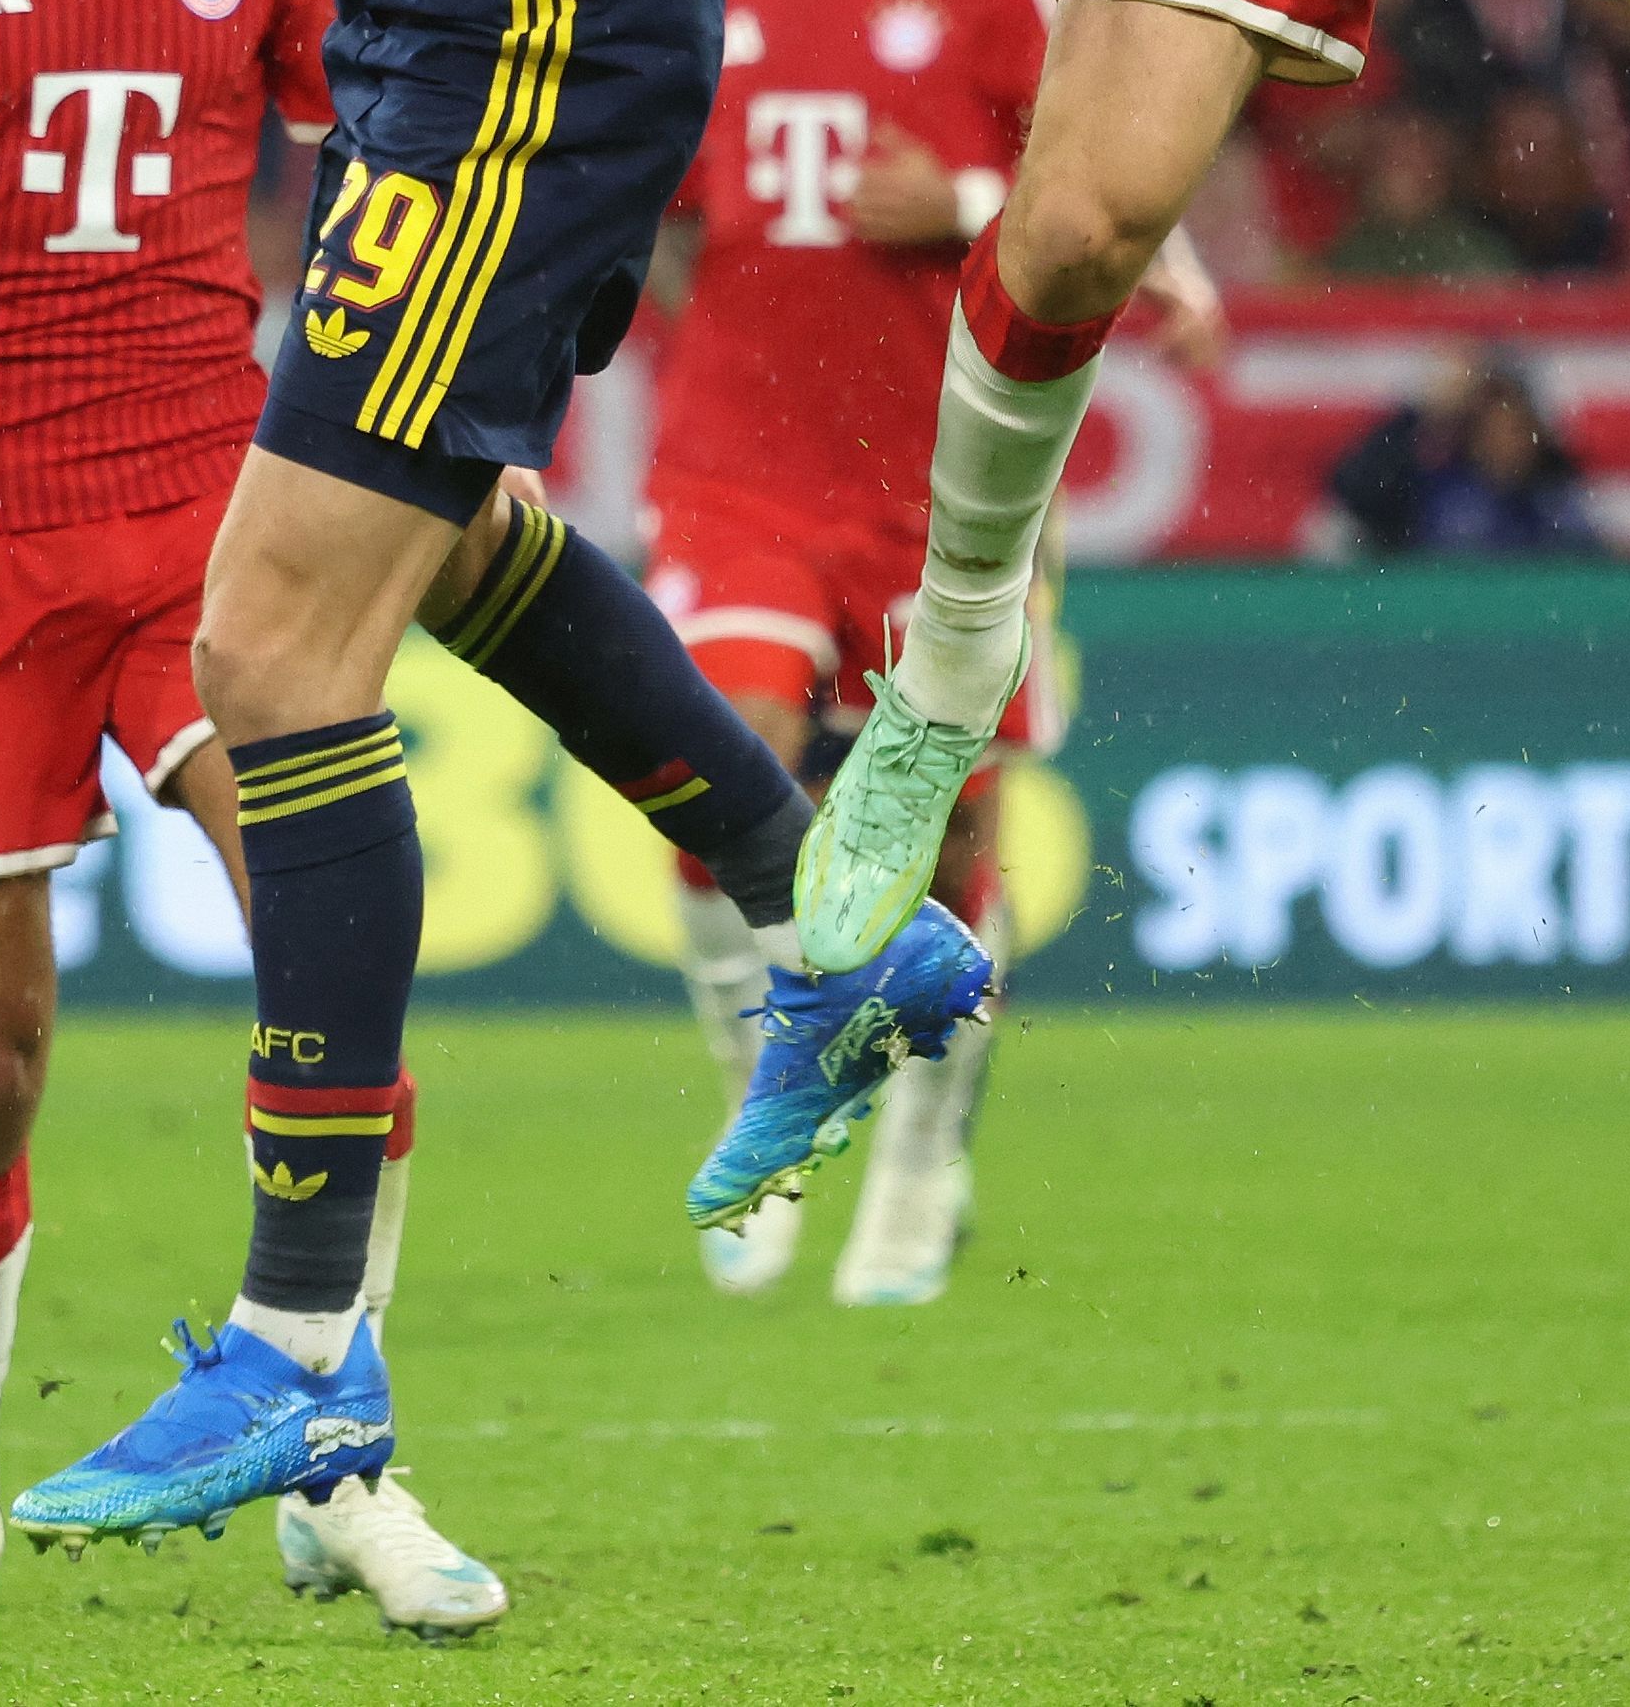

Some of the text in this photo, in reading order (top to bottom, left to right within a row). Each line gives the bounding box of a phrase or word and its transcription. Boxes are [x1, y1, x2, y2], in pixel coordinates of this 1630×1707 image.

[22, 70, 183, 253] T
[302, 156, 444, 313] 29
[745, 91, 869, 248] T
[250, 1021, 326, 1064] AFC
